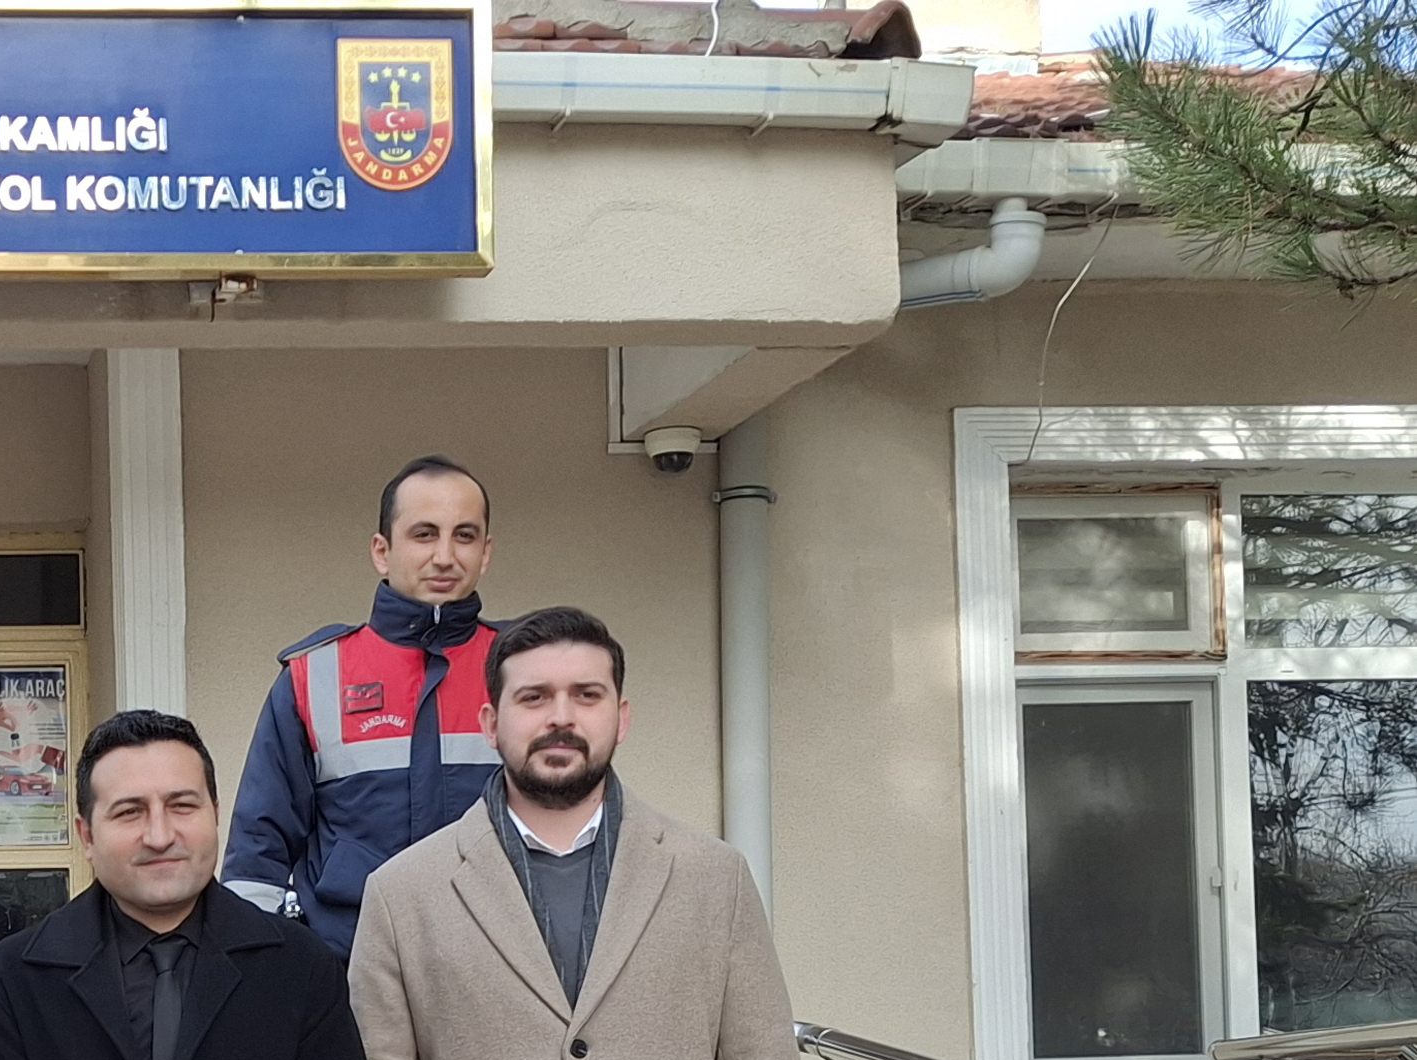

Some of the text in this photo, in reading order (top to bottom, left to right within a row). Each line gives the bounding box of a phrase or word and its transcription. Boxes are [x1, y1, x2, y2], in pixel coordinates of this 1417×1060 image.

[347, 137, 445, 182] JANDARMA
[66, 167, 347, 211] KOMUTANLIĞI
[25, 679, 65, 702] ARAÇ
[359, 715, 406, 734] JANDARMA
